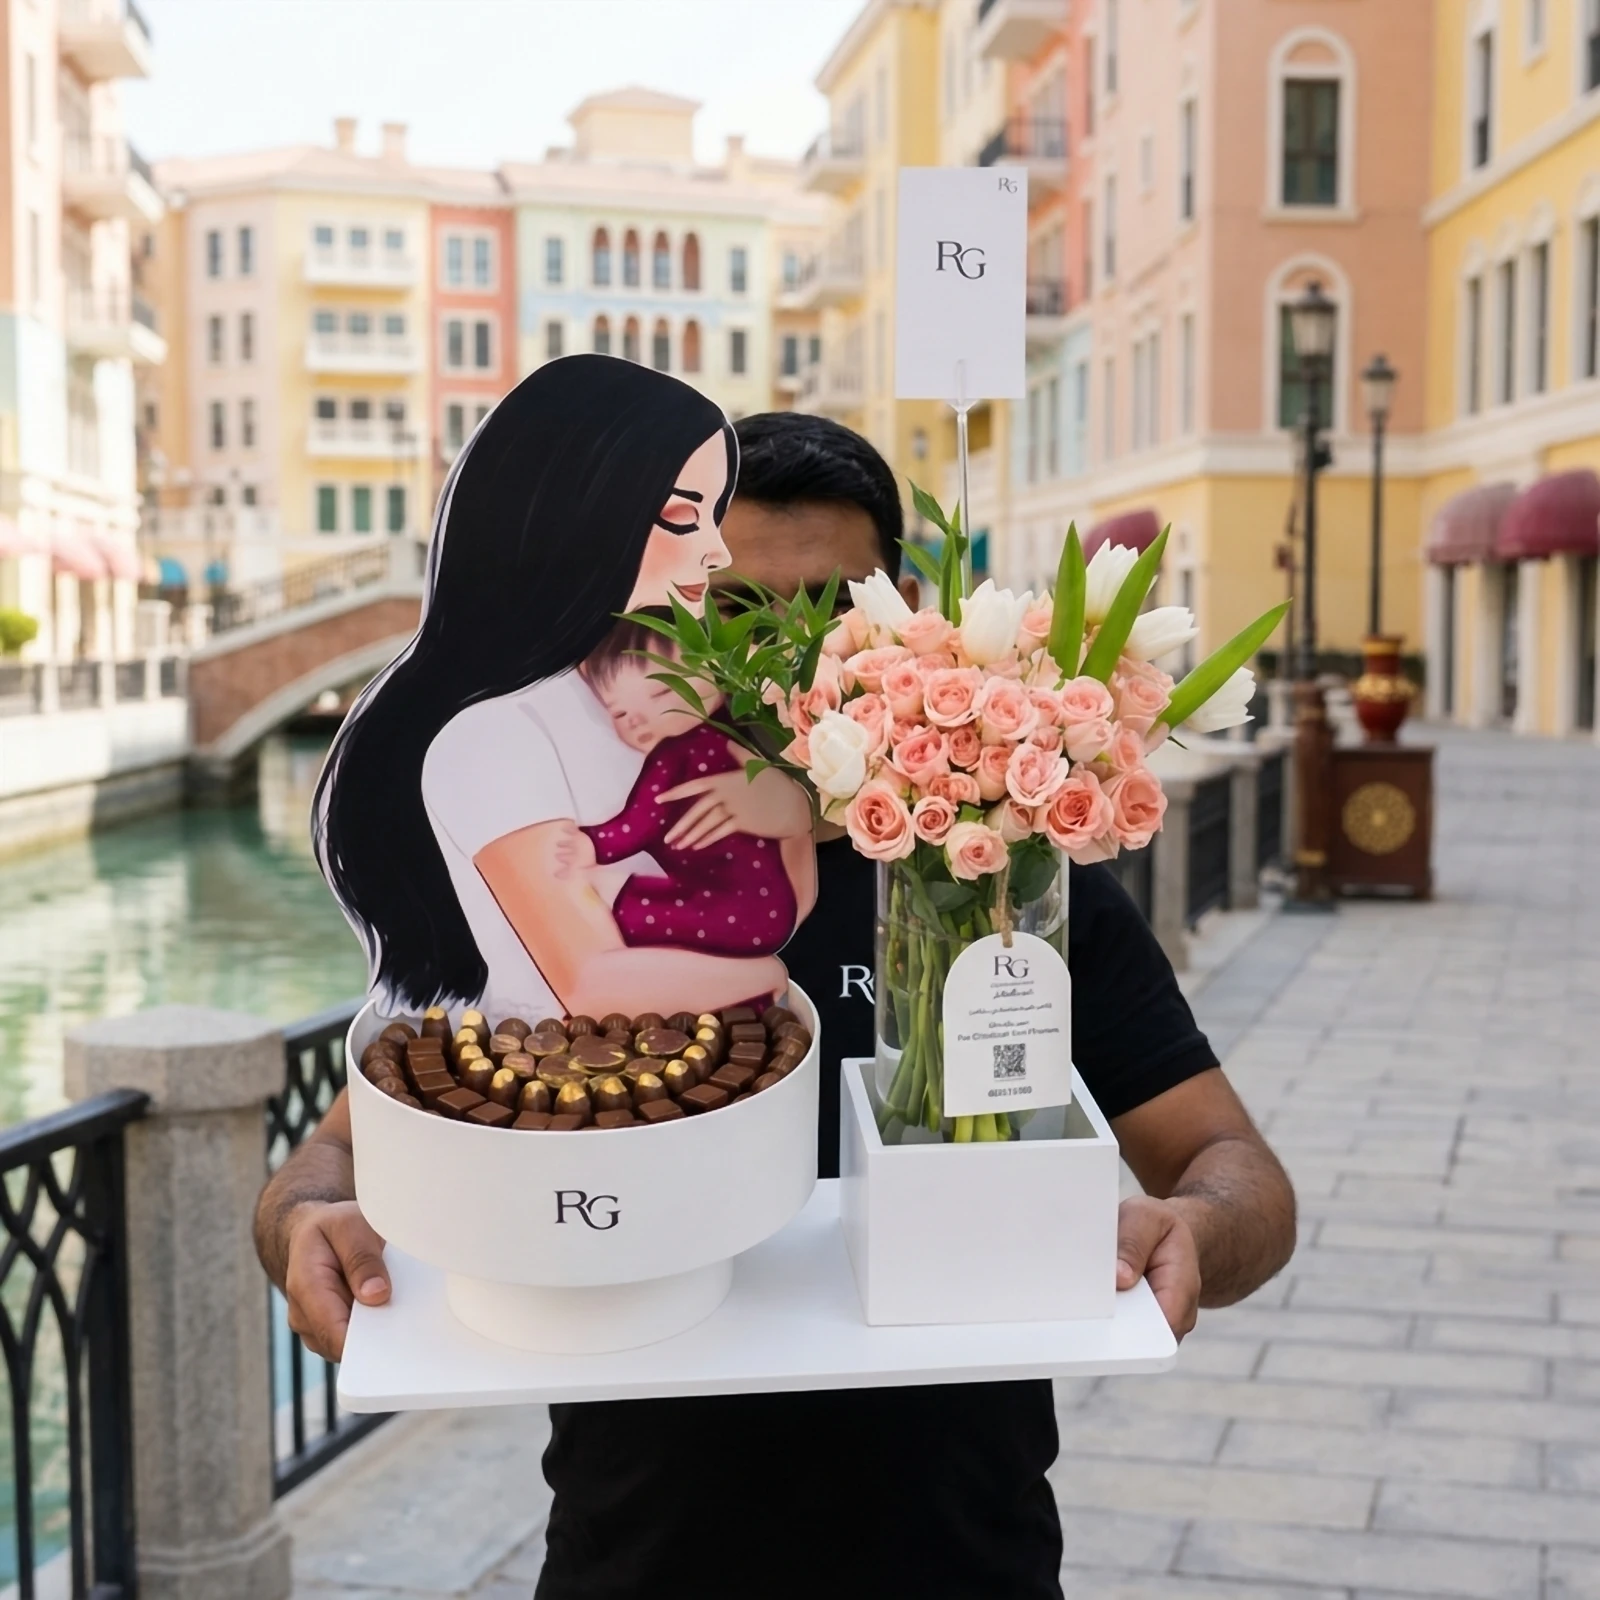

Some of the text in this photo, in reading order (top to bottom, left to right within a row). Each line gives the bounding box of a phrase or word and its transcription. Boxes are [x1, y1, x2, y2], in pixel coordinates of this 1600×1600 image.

[998, 177, 1018, 194] RG
[936, 240, 987, 280] RG
[839, 965, 875, 1005] R
[994, 955, 1030, 979] RG
[554, 1190, 622, 1230] RG
